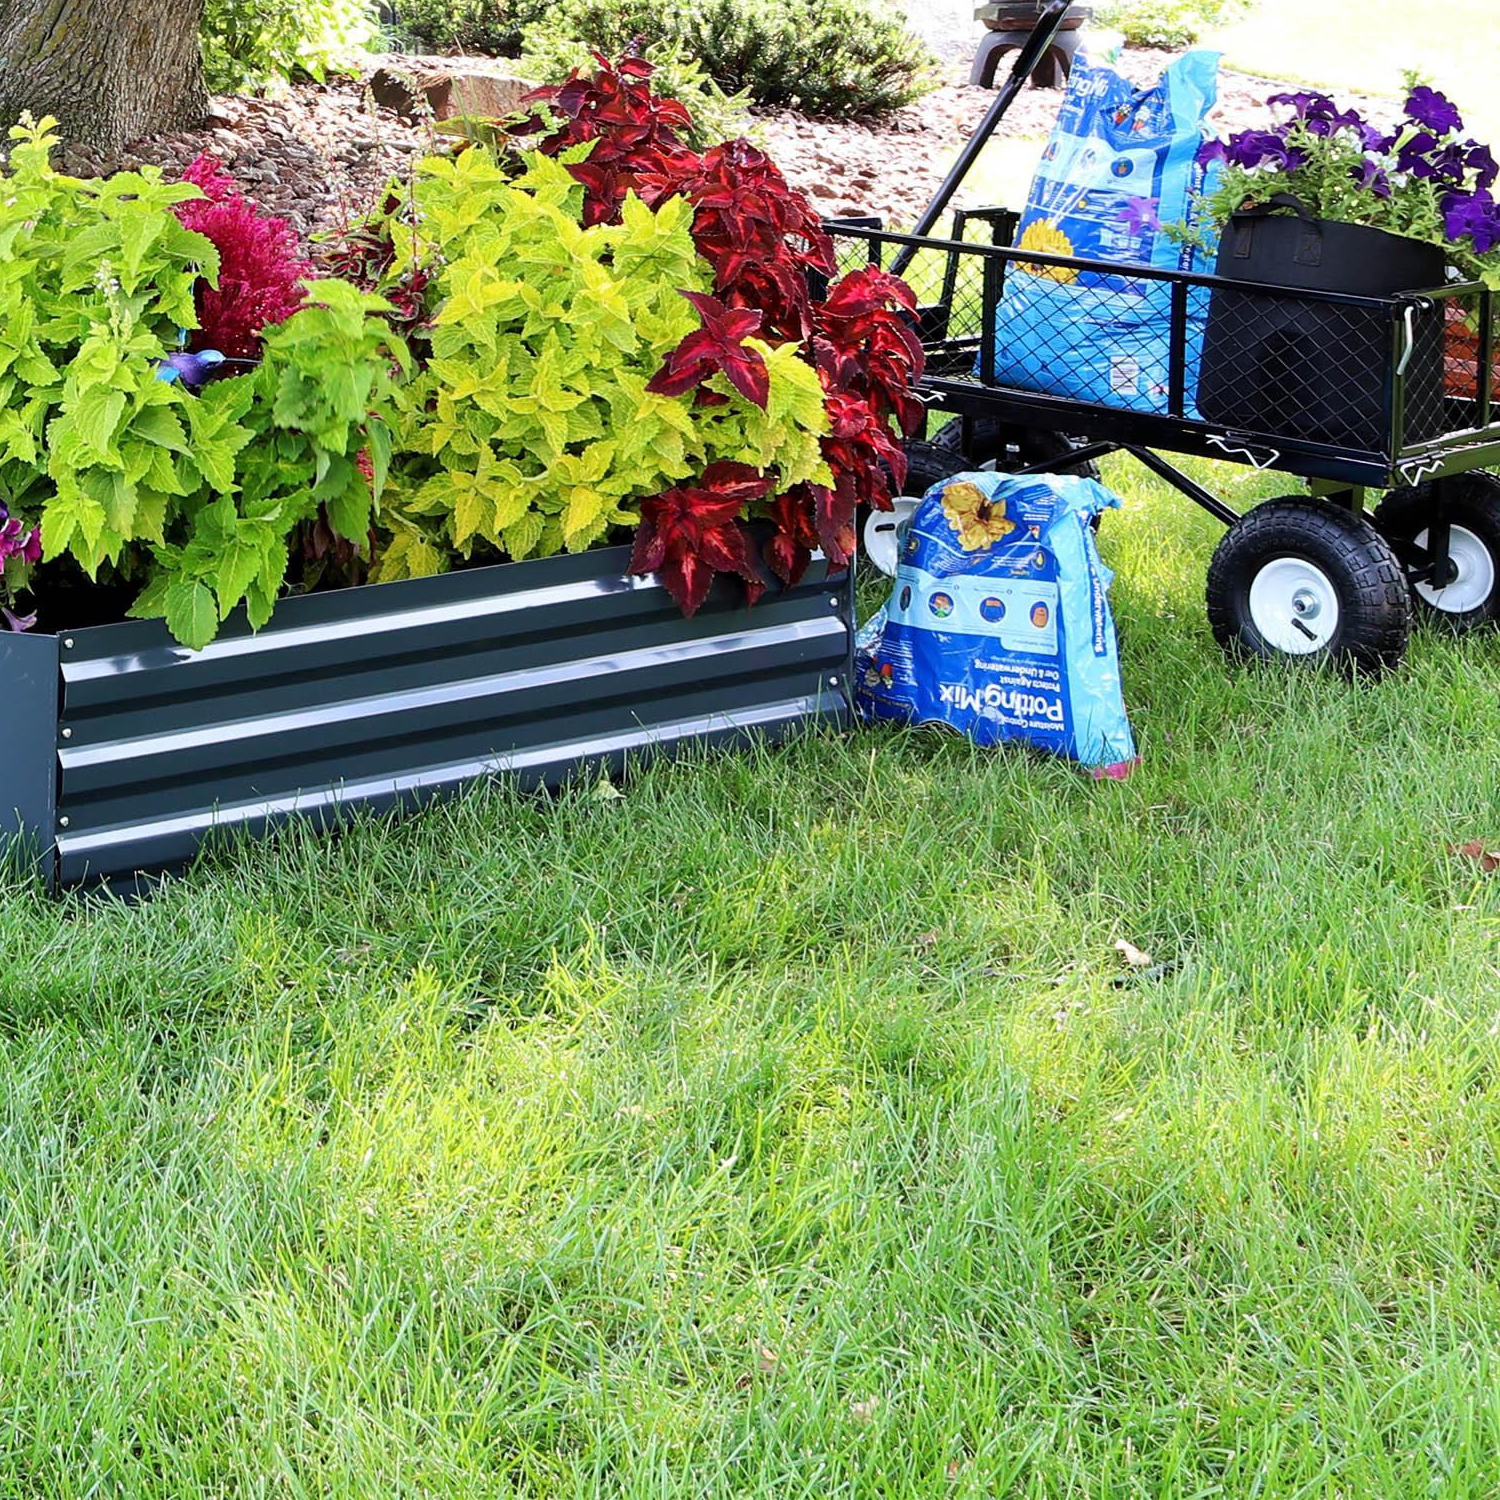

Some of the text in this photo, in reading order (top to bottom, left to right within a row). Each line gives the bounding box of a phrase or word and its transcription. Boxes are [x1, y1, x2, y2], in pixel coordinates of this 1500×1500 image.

[974, 659, 1038, 677] Underwatering
[1037, 668, 1045, 678] &
[999, 675, 1061, 693] Protects Against
[939, 683, 982, 711] Mix
[984, 684, 1064, 722] Potting
[1029, 720, 1065, 732] Moisture
